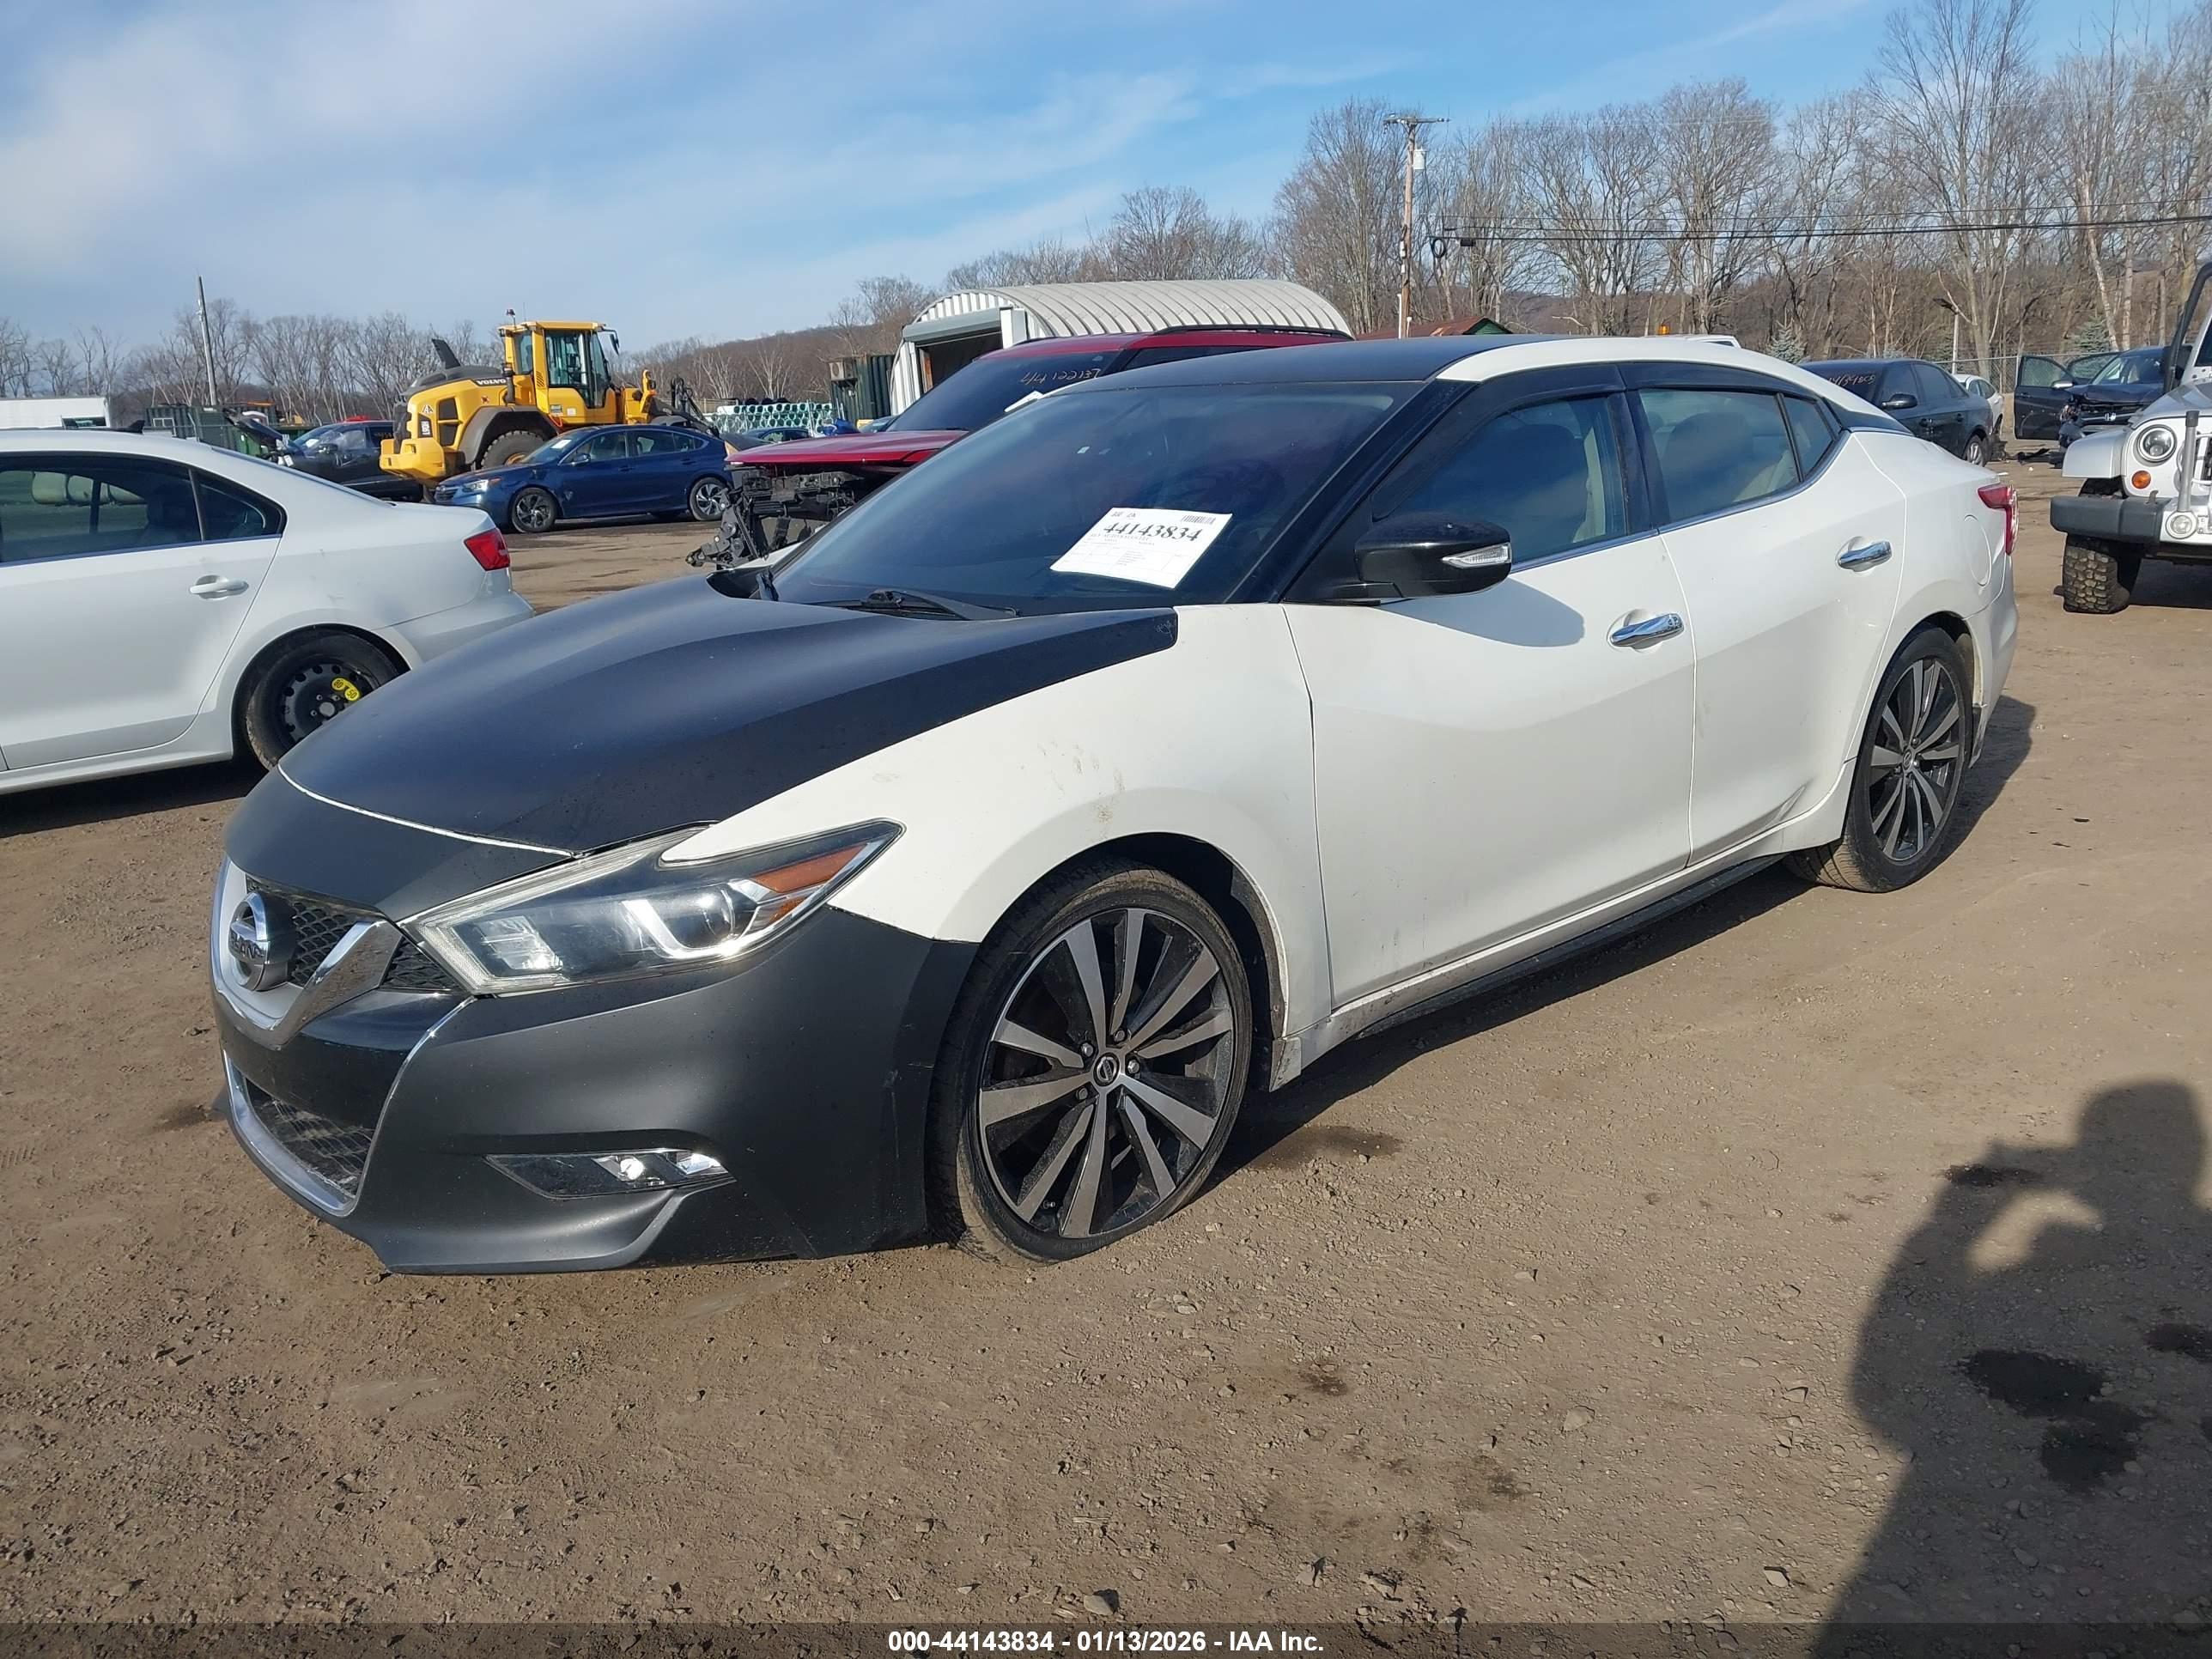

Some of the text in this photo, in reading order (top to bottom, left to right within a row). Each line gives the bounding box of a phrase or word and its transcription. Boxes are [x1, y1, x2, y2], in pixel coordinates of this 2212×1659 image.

[1103, 522, 1203, 541] 44143834
[333, 679, 343, 689] 80
[346, 690, 358, 699] 50
